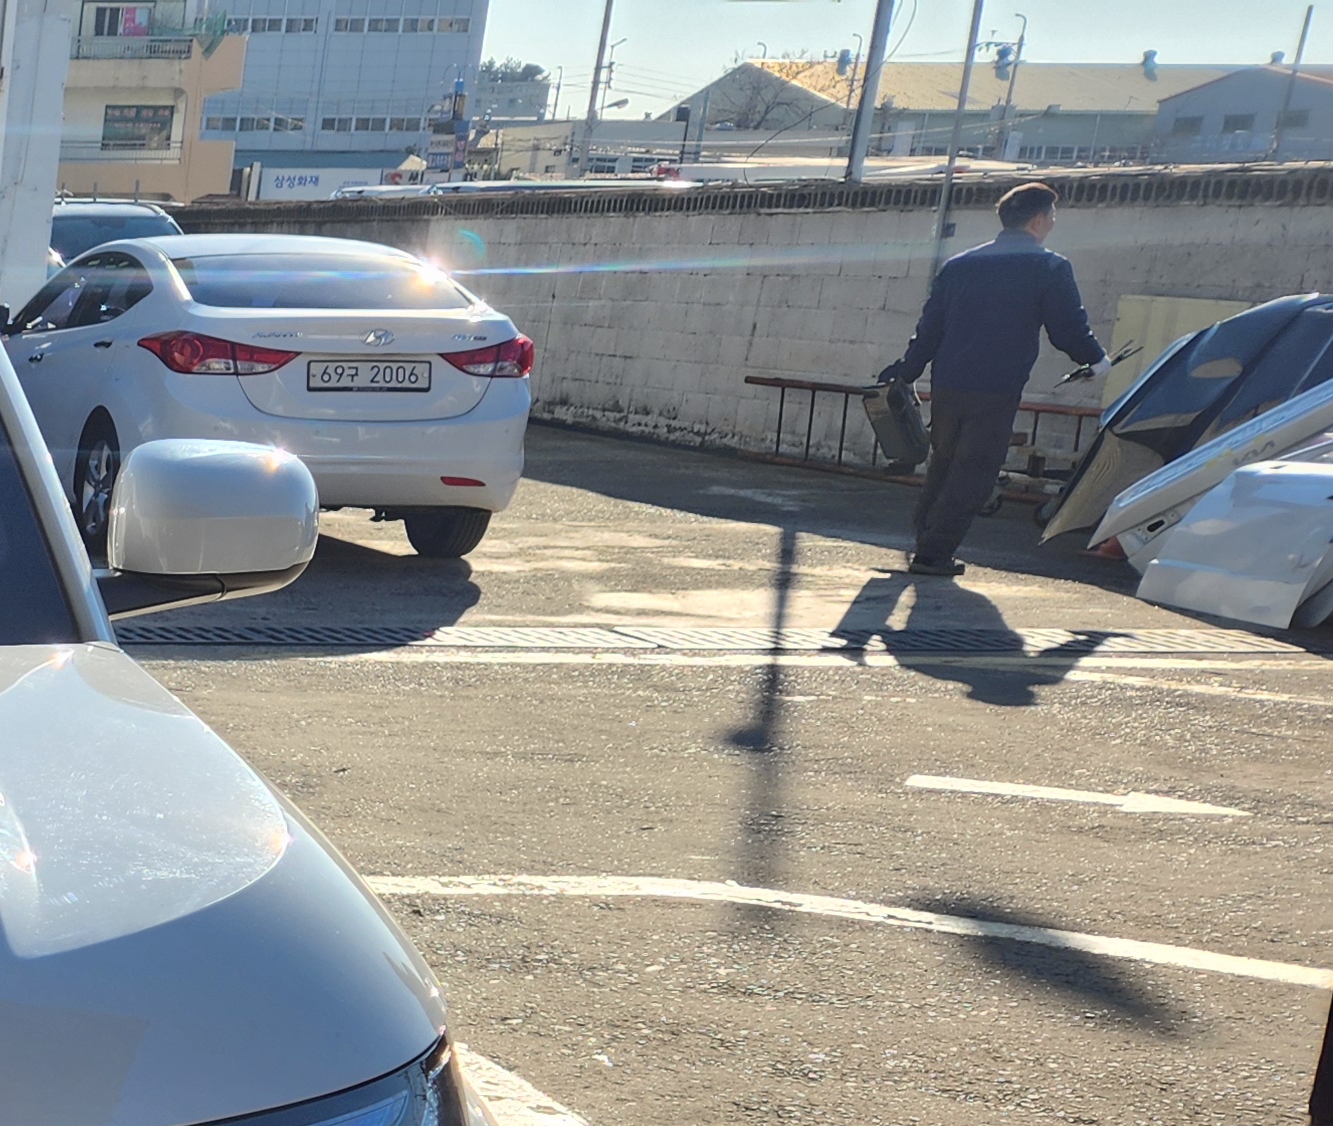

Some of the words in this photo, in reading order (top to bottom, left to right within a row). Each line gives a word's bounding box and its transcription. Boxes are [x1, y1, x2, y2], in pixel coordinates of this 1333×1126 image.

[274, 174, 320, 189] 삼성화재
[320, 364, 359, 384] 69구
[369, 364, 420, 385] 2006
